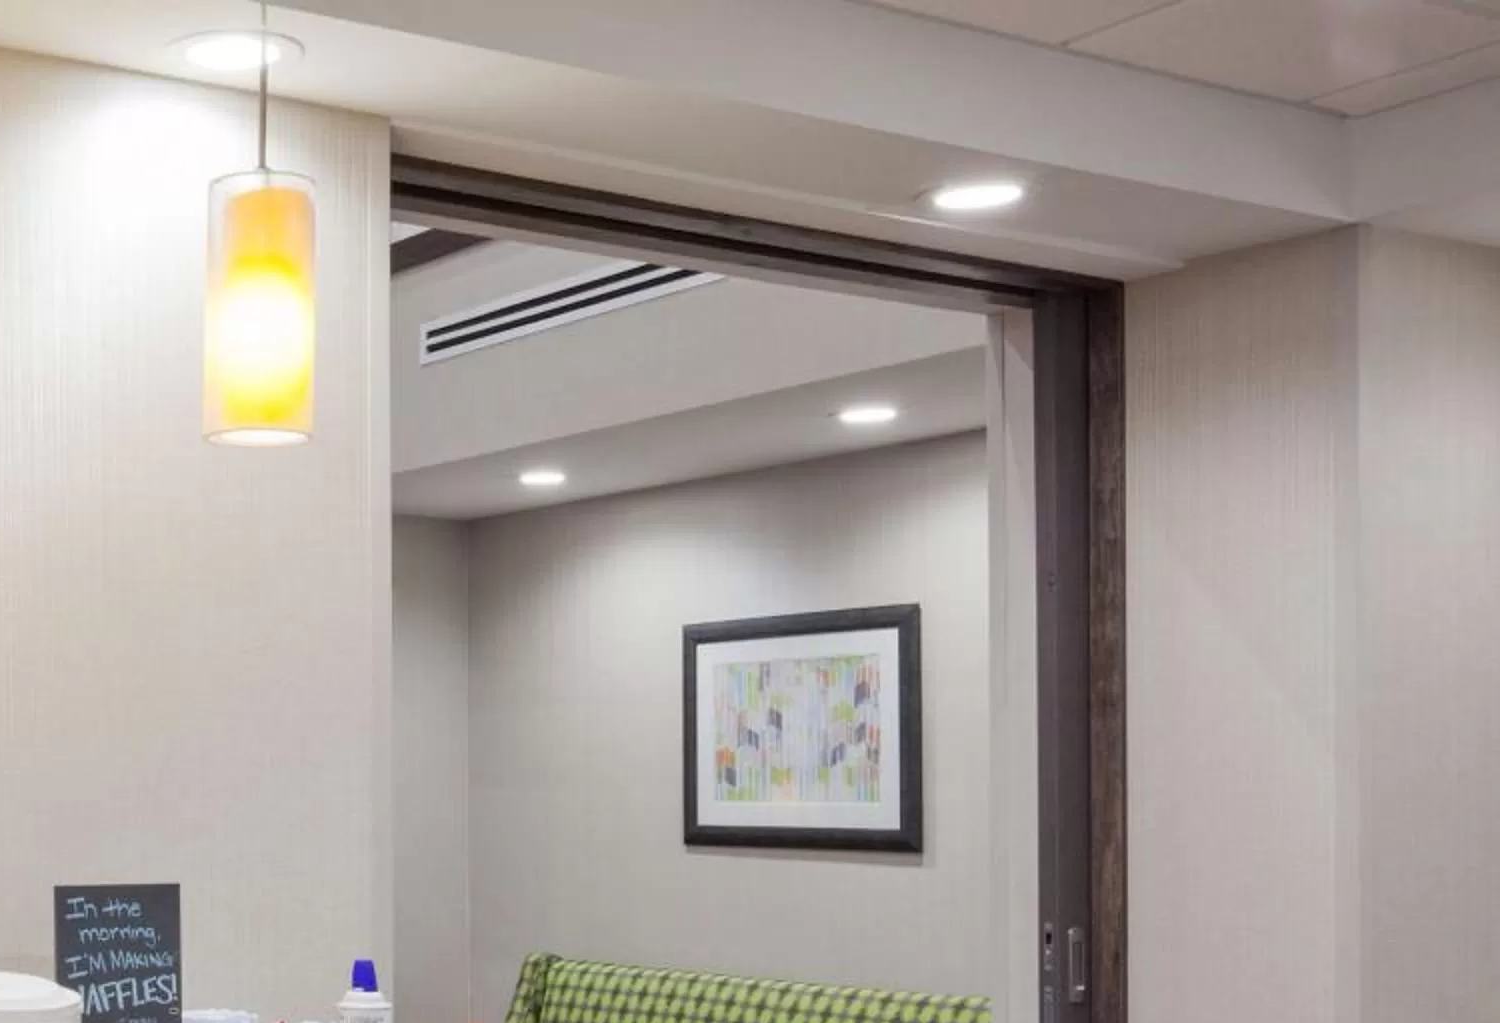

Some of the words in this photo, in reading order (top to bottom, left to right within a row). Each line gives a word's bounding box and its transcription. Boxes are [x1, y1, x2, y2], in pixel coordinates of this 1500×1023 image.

[65, 897, 98, 920] In
[102, 898, 143, 918] the
[111, 949, 175, 972] MAKING
[79, 973, 179, 1016] AFFLES!
